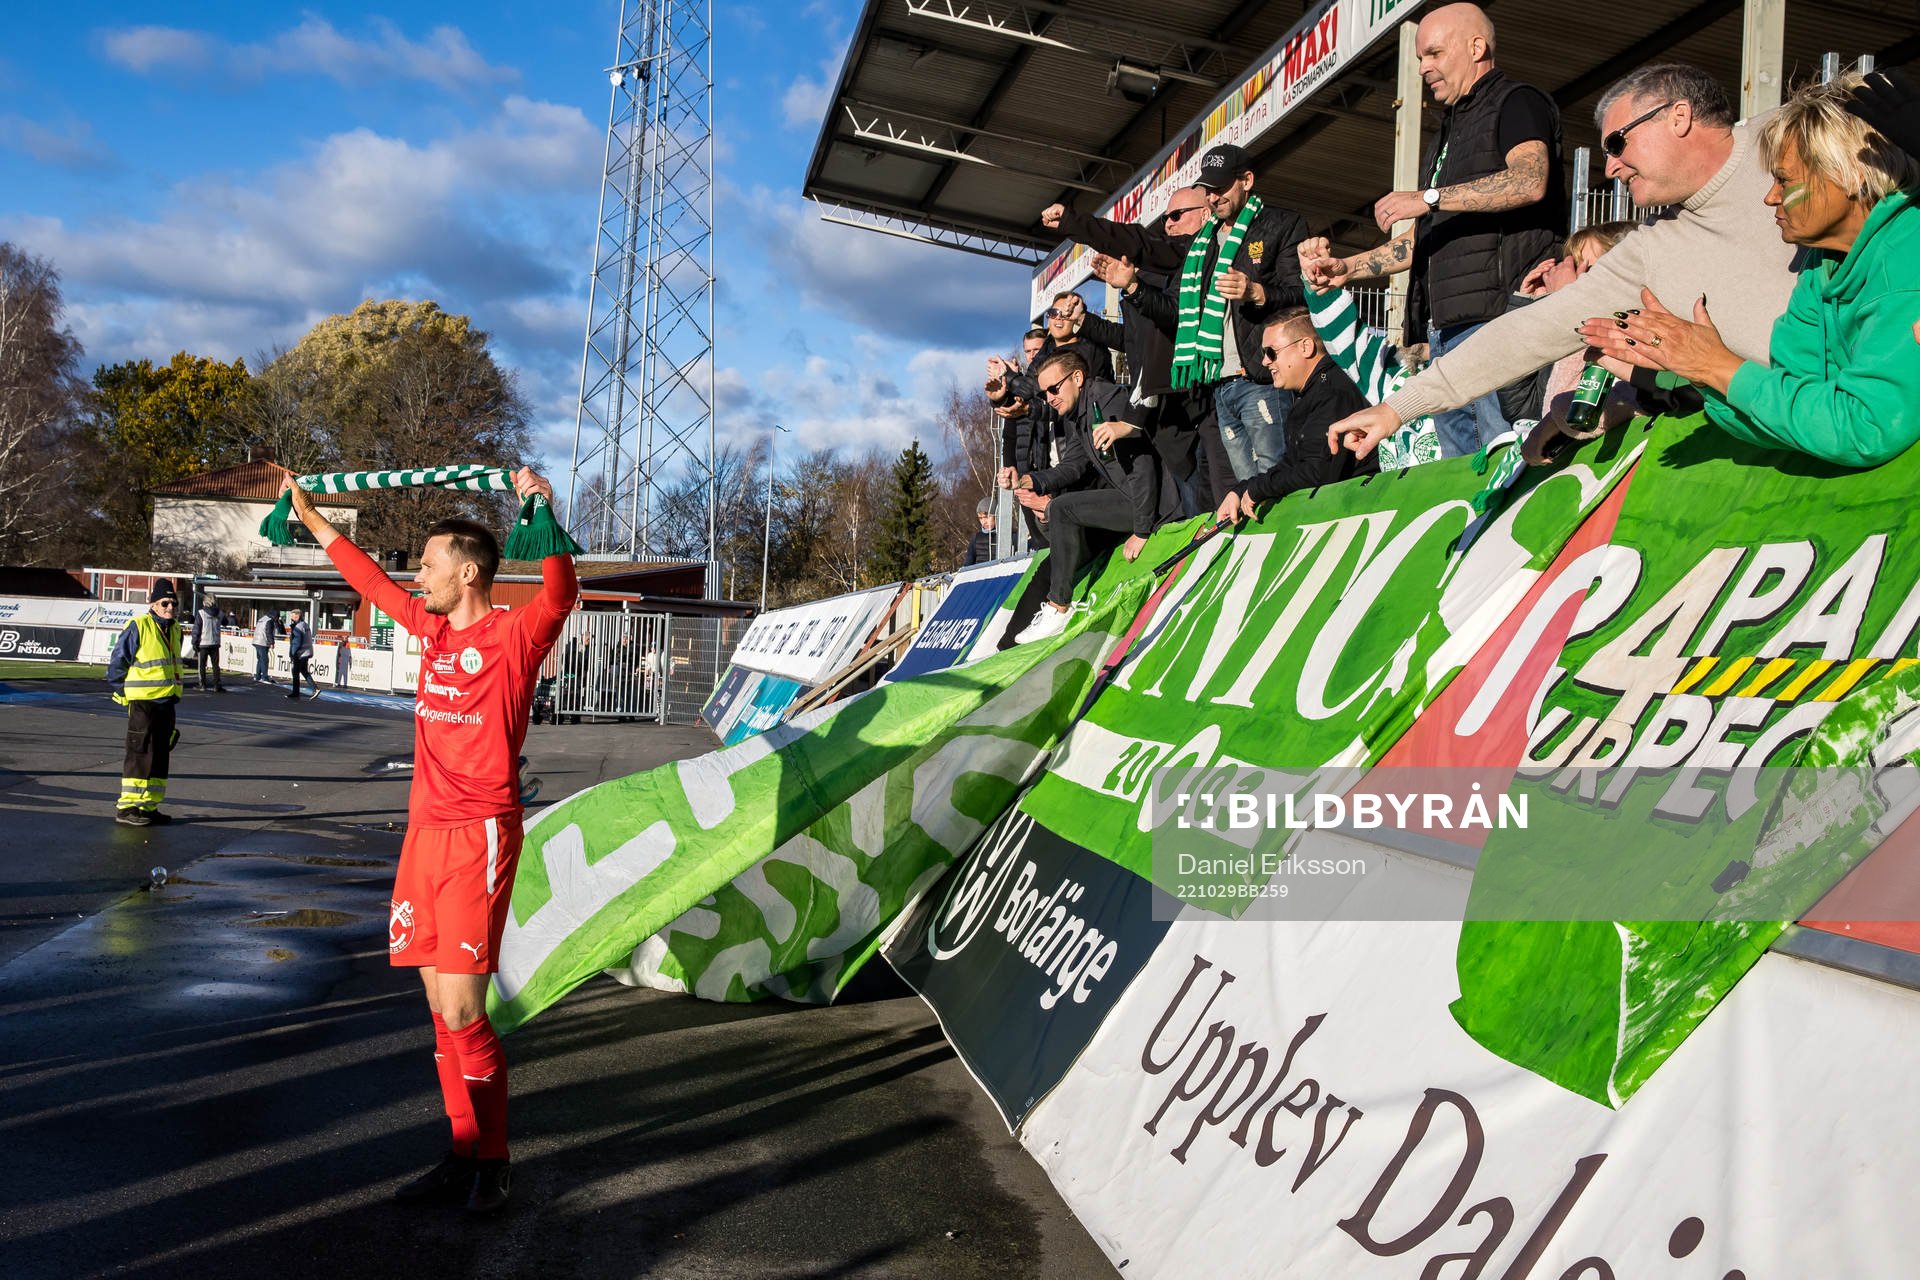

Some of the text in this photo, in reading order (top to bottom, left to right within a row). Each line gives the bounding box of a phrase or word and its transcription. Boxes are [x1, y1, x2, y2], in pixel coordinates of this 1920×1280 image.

[1283, 6, 1338, 92] MAXI
[1292, 51, 1337, 99] STORMARKNAD
[1228, 102, 1268, 144] Dalarna
[1113, 184, 1143, 224] MAXI
[99, 606, 134, 617] vensk
[17, 645, 62, 655] INSTALCO
[994, 861, 1118, 1010] Borlänge
[1141, 954, 1364, 1194] Upplev
